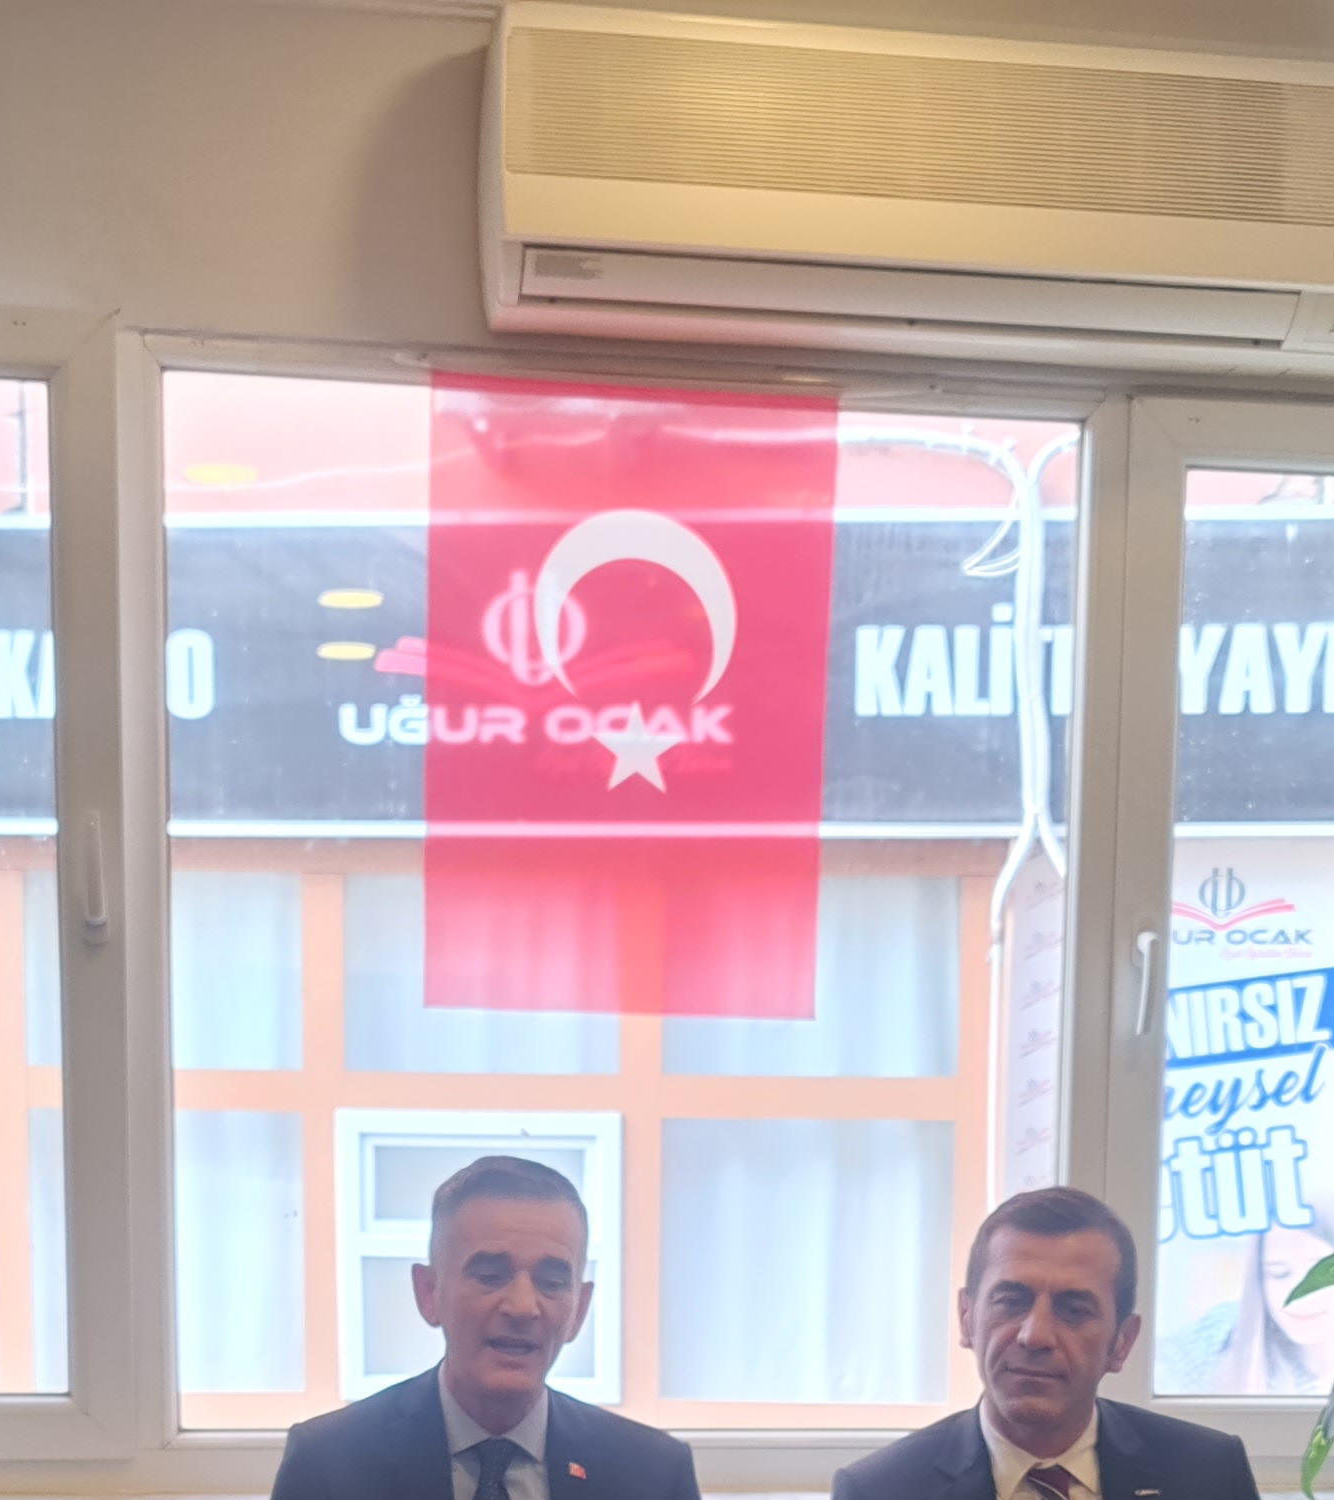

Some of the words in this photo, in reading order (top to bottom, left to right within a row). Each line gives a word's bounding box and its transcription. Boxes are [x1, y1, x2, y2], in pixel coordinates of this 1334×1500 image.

[338, 694, 527, 746] UĞUR
[1171, 928, 1216, 946] UR
[1225, 928, 1314, 946] OCAK
[1167, 974, 1333, 1060] NIRSIZ
[1164, 1043, 1327, 1136] eysel
